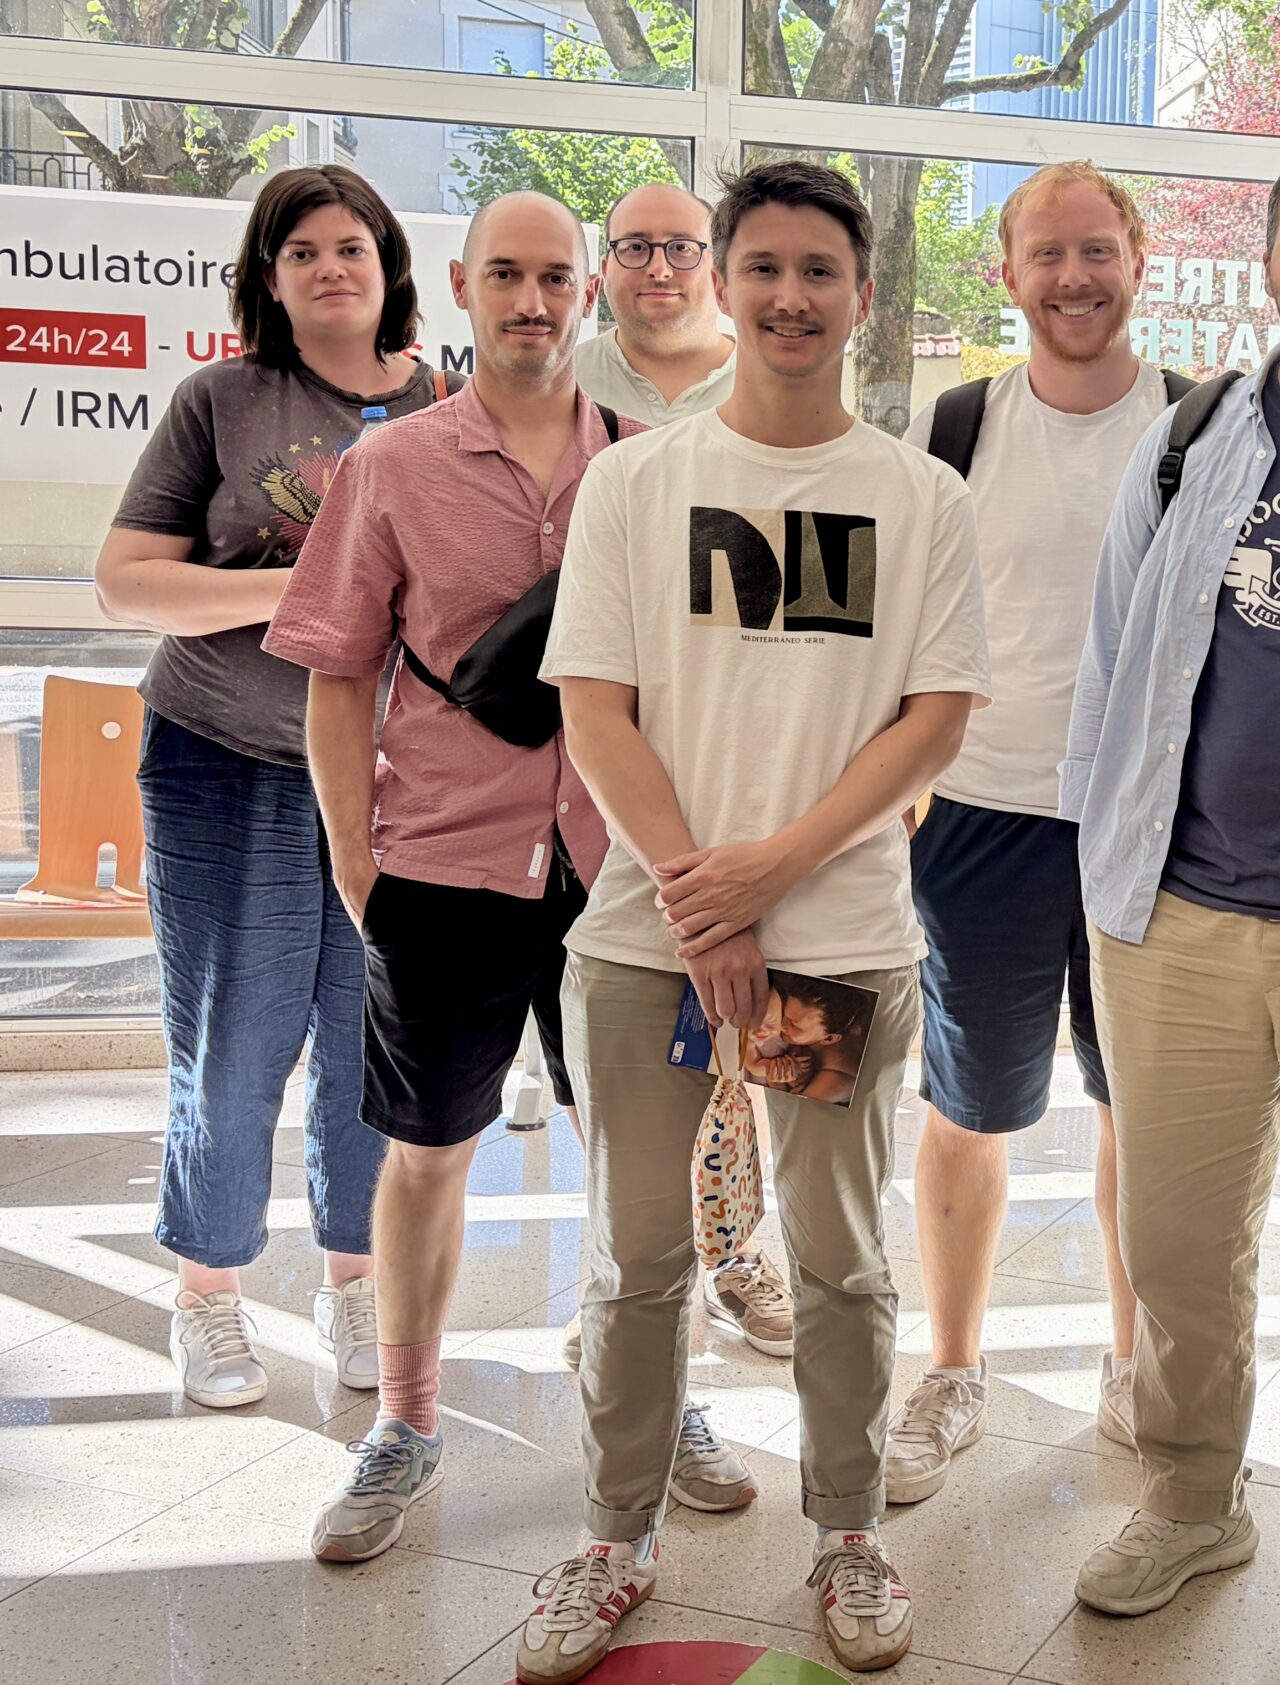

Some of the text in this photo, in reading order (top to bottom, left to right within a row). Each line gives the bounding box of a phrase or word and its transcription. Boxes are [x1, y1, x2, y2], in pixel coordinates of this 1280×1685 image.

[5, 325, 133, 357] 24h/24
[57, 389, 148, 430] IRM
[1258, 608, 1280, 624] EST.
